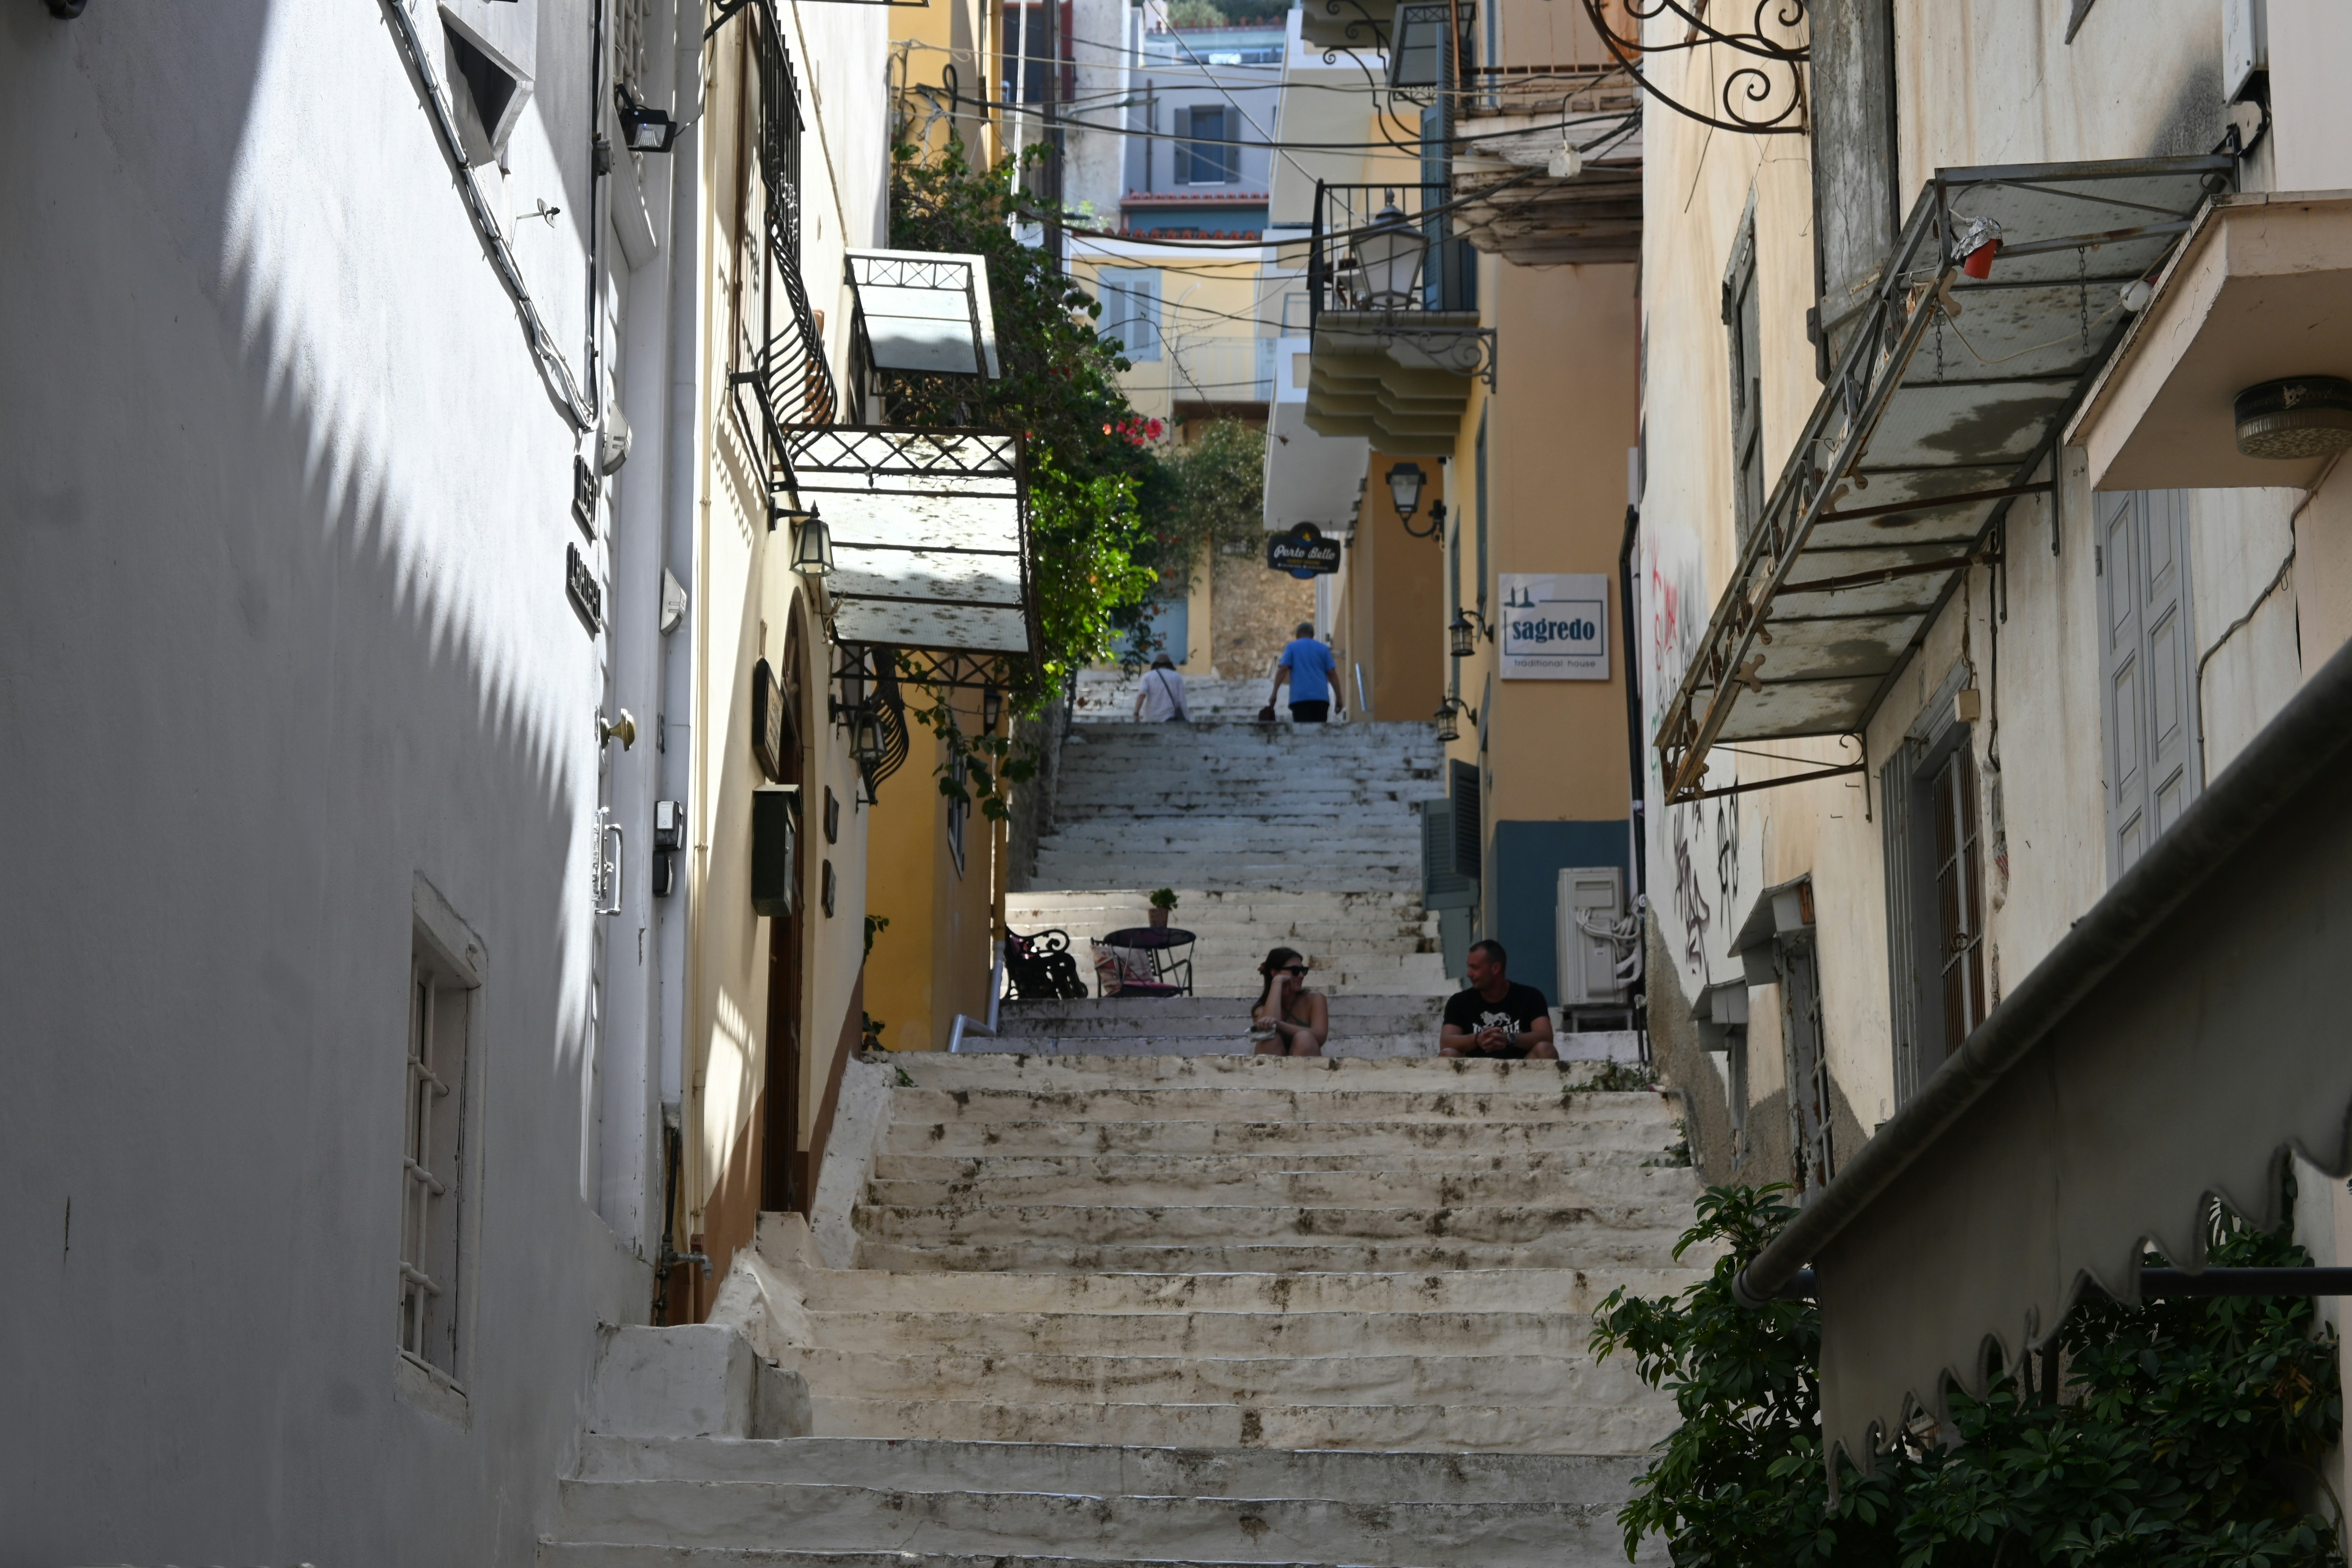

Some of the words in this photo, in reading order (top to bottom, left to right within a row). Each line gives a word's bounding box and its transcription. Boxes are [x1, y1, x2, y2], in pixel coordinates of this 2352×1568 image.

[1274, 544, 1305, 558] Porto
[1308, 547, 1335, 560] Bello
[1512, 618, 1595, 643] sagredo
